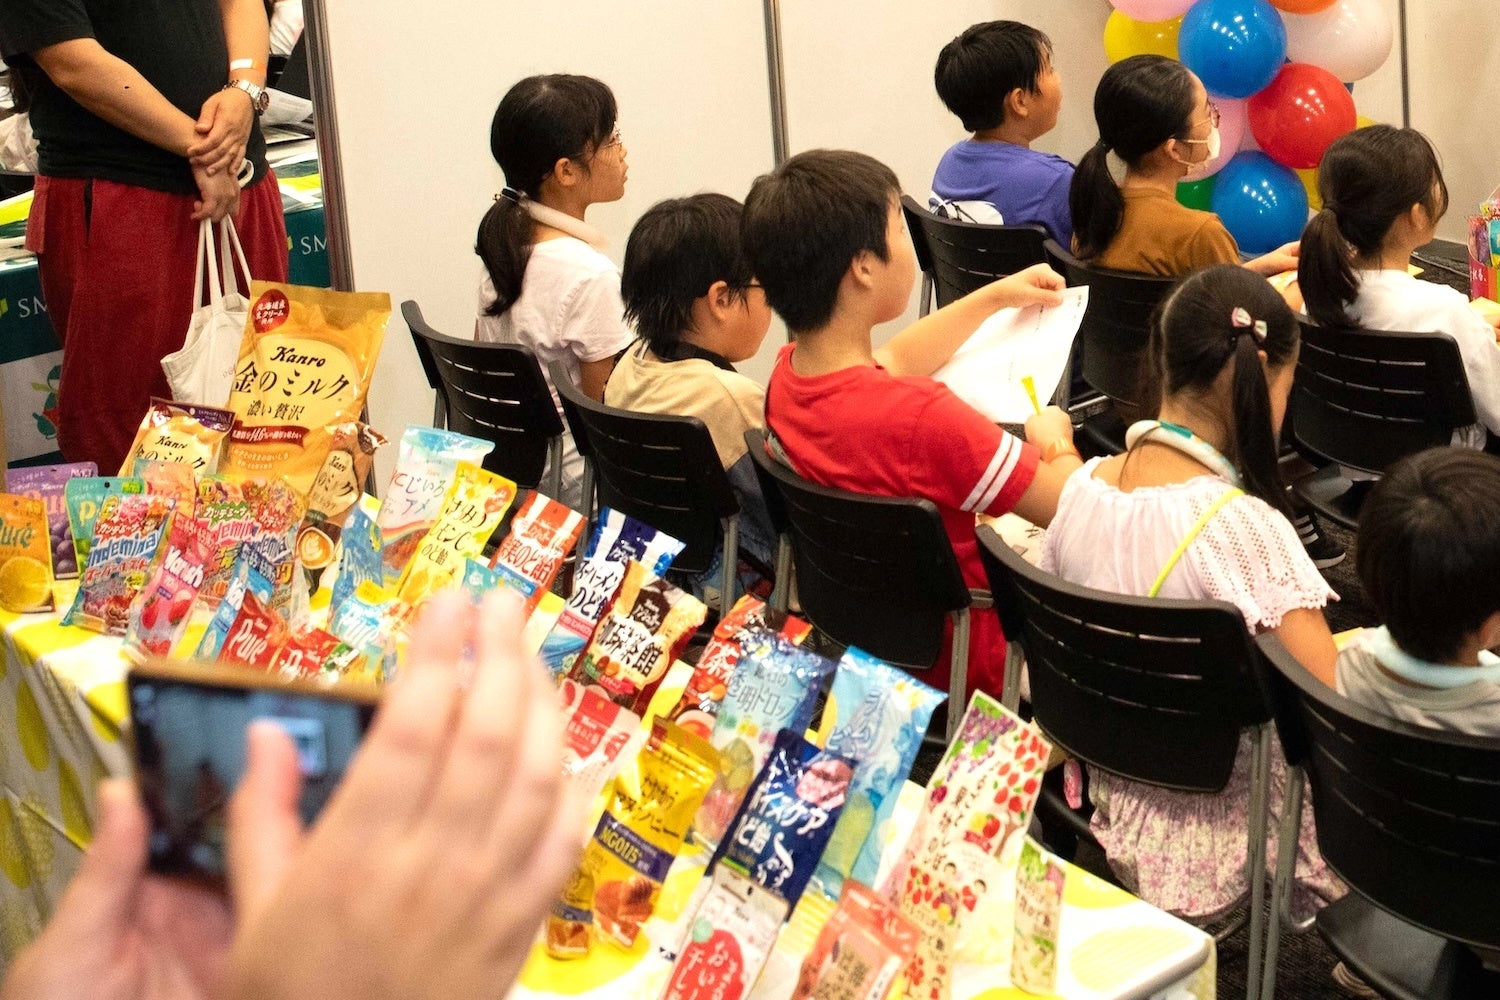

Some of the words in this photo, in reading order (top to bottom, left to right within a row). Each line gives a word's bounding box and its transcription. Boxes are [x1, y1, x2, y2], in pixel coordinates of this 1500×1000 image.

[270, 345, 327, 368] Kanro
[232, 361, 350, 401] 金のミルク
[247, 399, 305, 421] 濃い贅沢
[0, 516, 33, 549] uré
